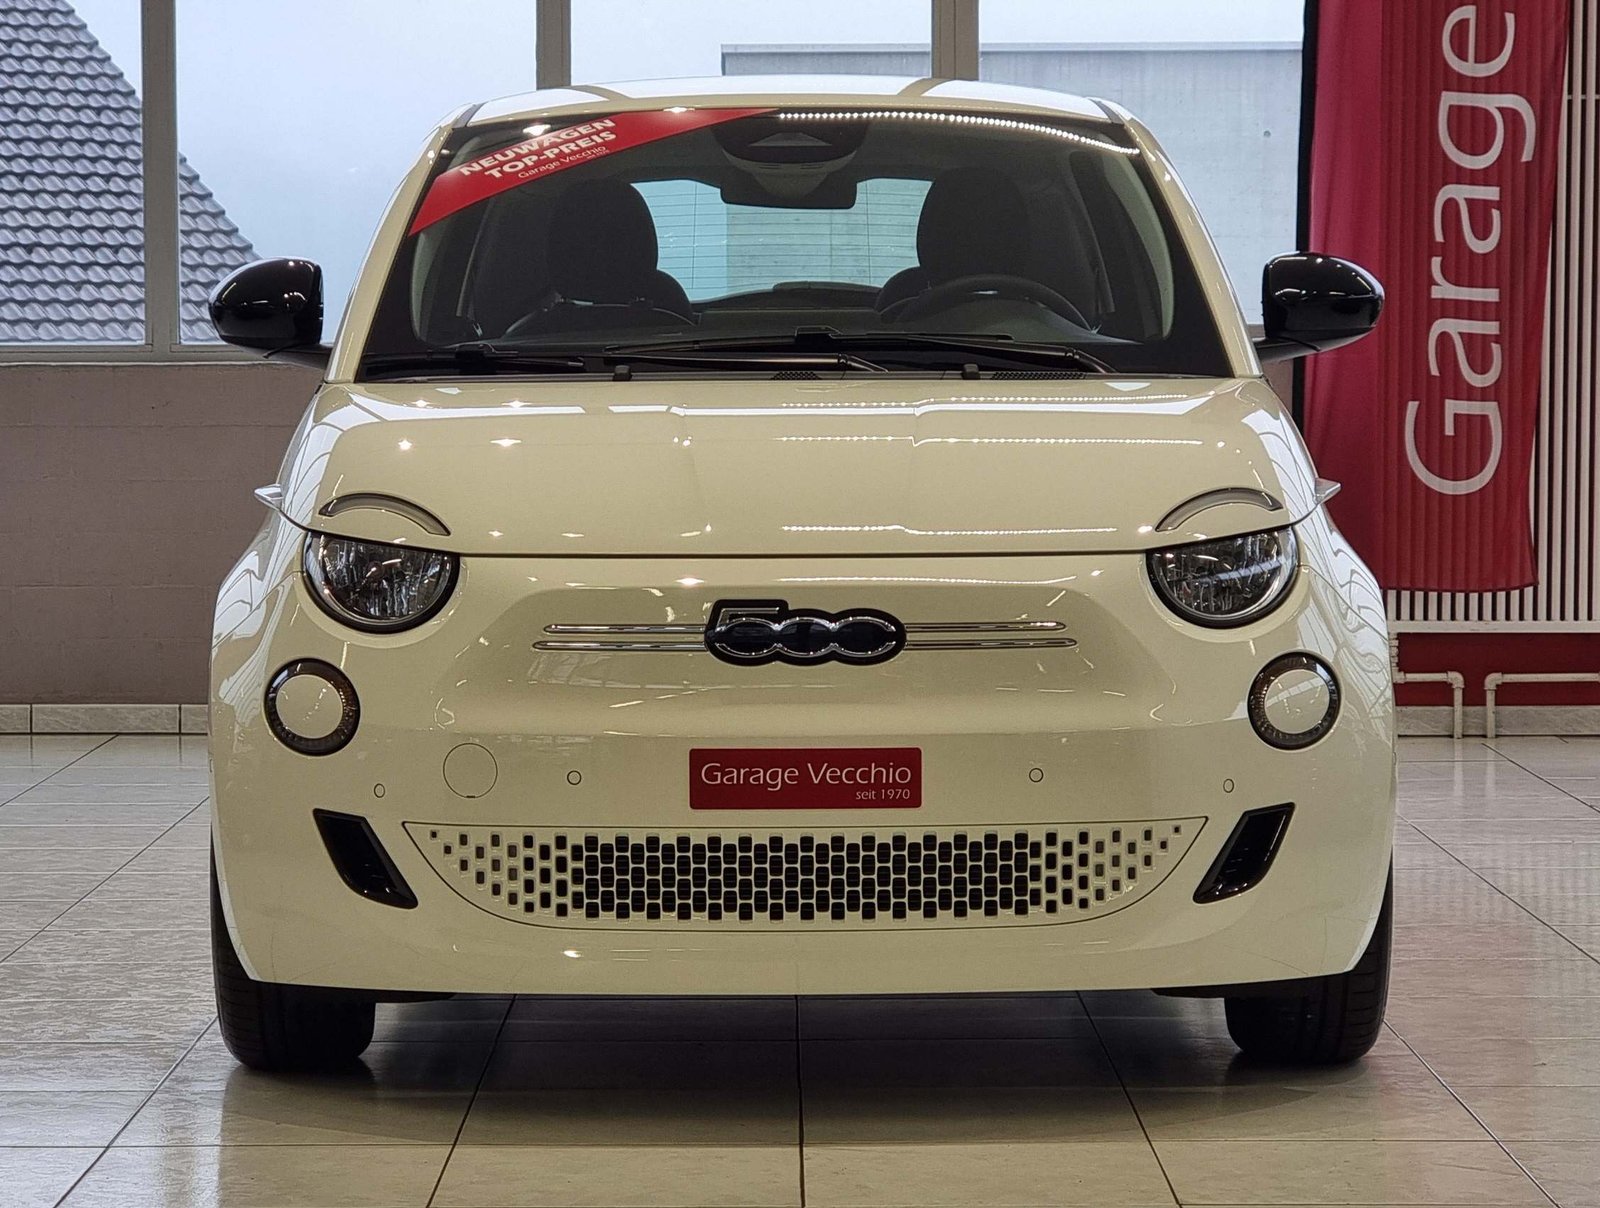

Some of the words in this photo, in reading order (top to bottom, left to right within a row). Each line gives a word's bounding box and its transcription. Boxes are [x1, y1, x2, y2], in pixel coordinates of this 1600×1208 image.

[459, 119, 616, 176] NEUWAGEN
[484, 130, 617, 179] TOP-PREIS
[517, 160, 561, 179] Garage
[560, 145, 607, 163] Vecchio
[1404, 4, 1536, 496] Garage
[705, 600, 906, 665] 500
[701, 763, 799, 791] Garage
[807, 762, 912, 784] Vecchio
[855, 788, 876, 800] seit
[880, 788, 910, 800] 1970
